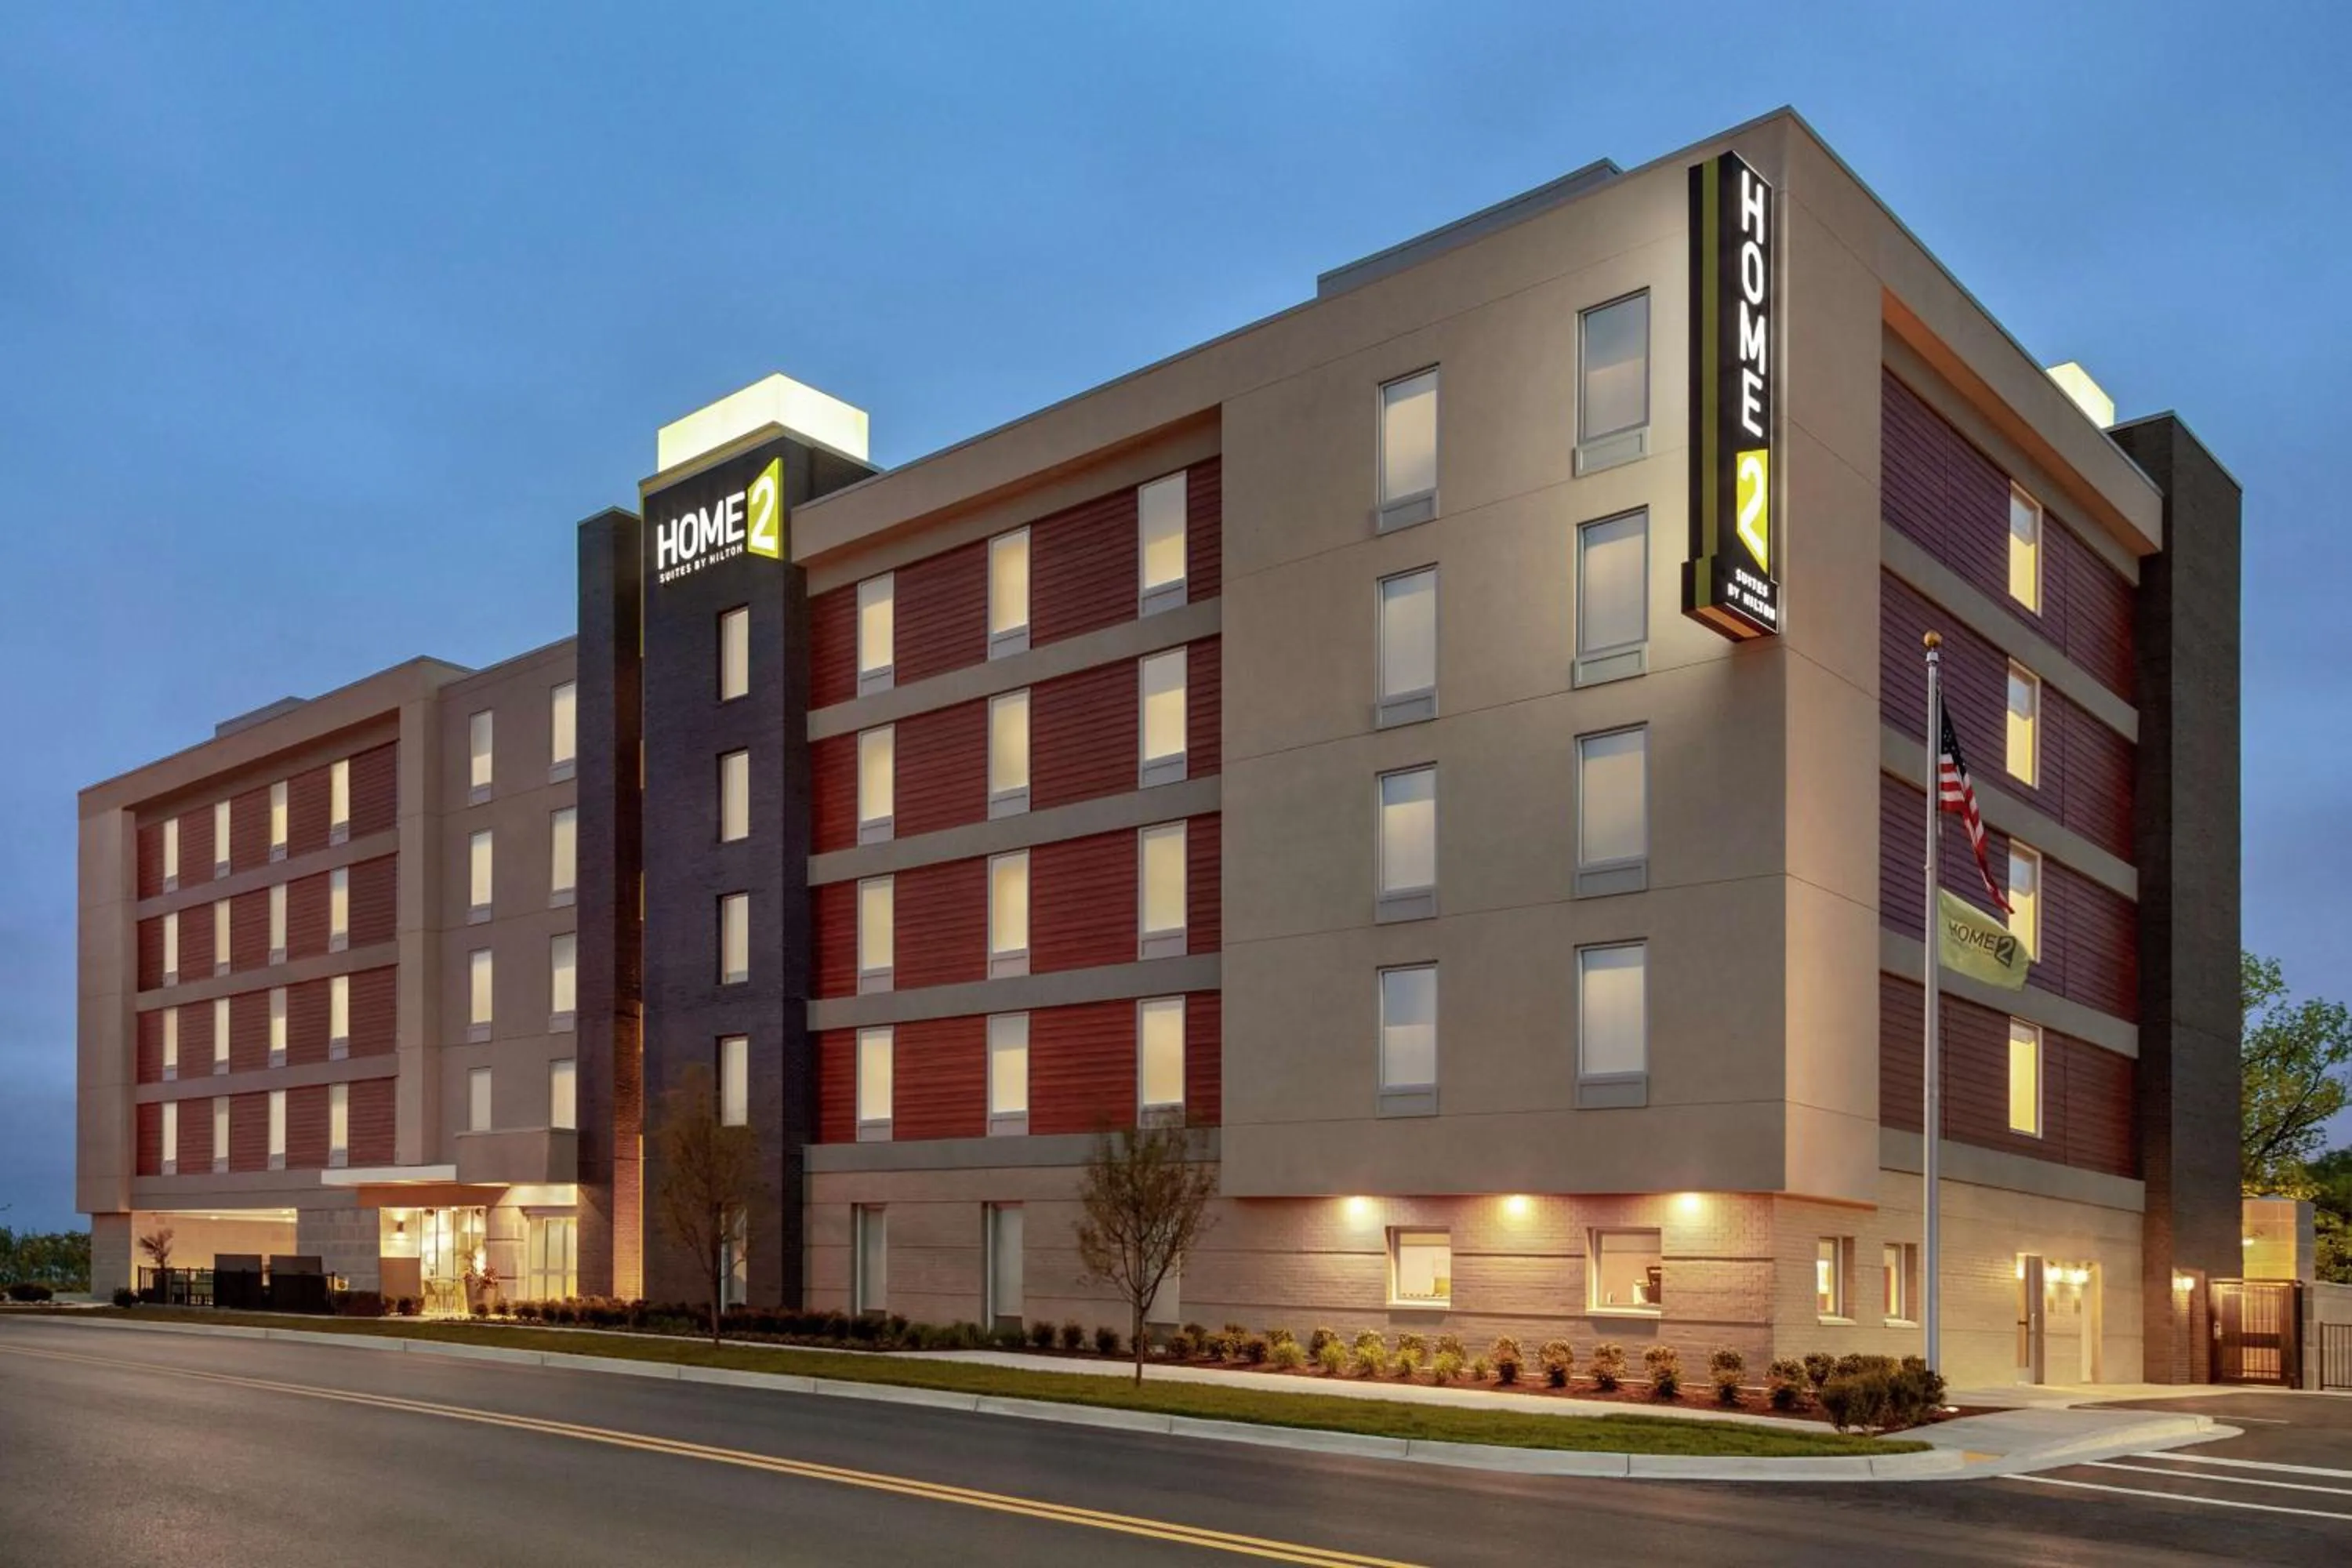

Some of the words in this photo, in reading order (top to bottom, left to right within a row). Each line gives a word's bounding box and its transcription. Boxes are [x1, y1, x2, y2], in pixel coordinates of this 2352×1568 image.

[659, 563, 691, 583] SUITES
[694, 557, 706, 571] BY
[709, 543, 742, 564] HILTON
[1736, 568, 1768, 597] SUITES
[1727, 583, 1740, 599] BY
[1743, 592, 1776, 621] HILTON
